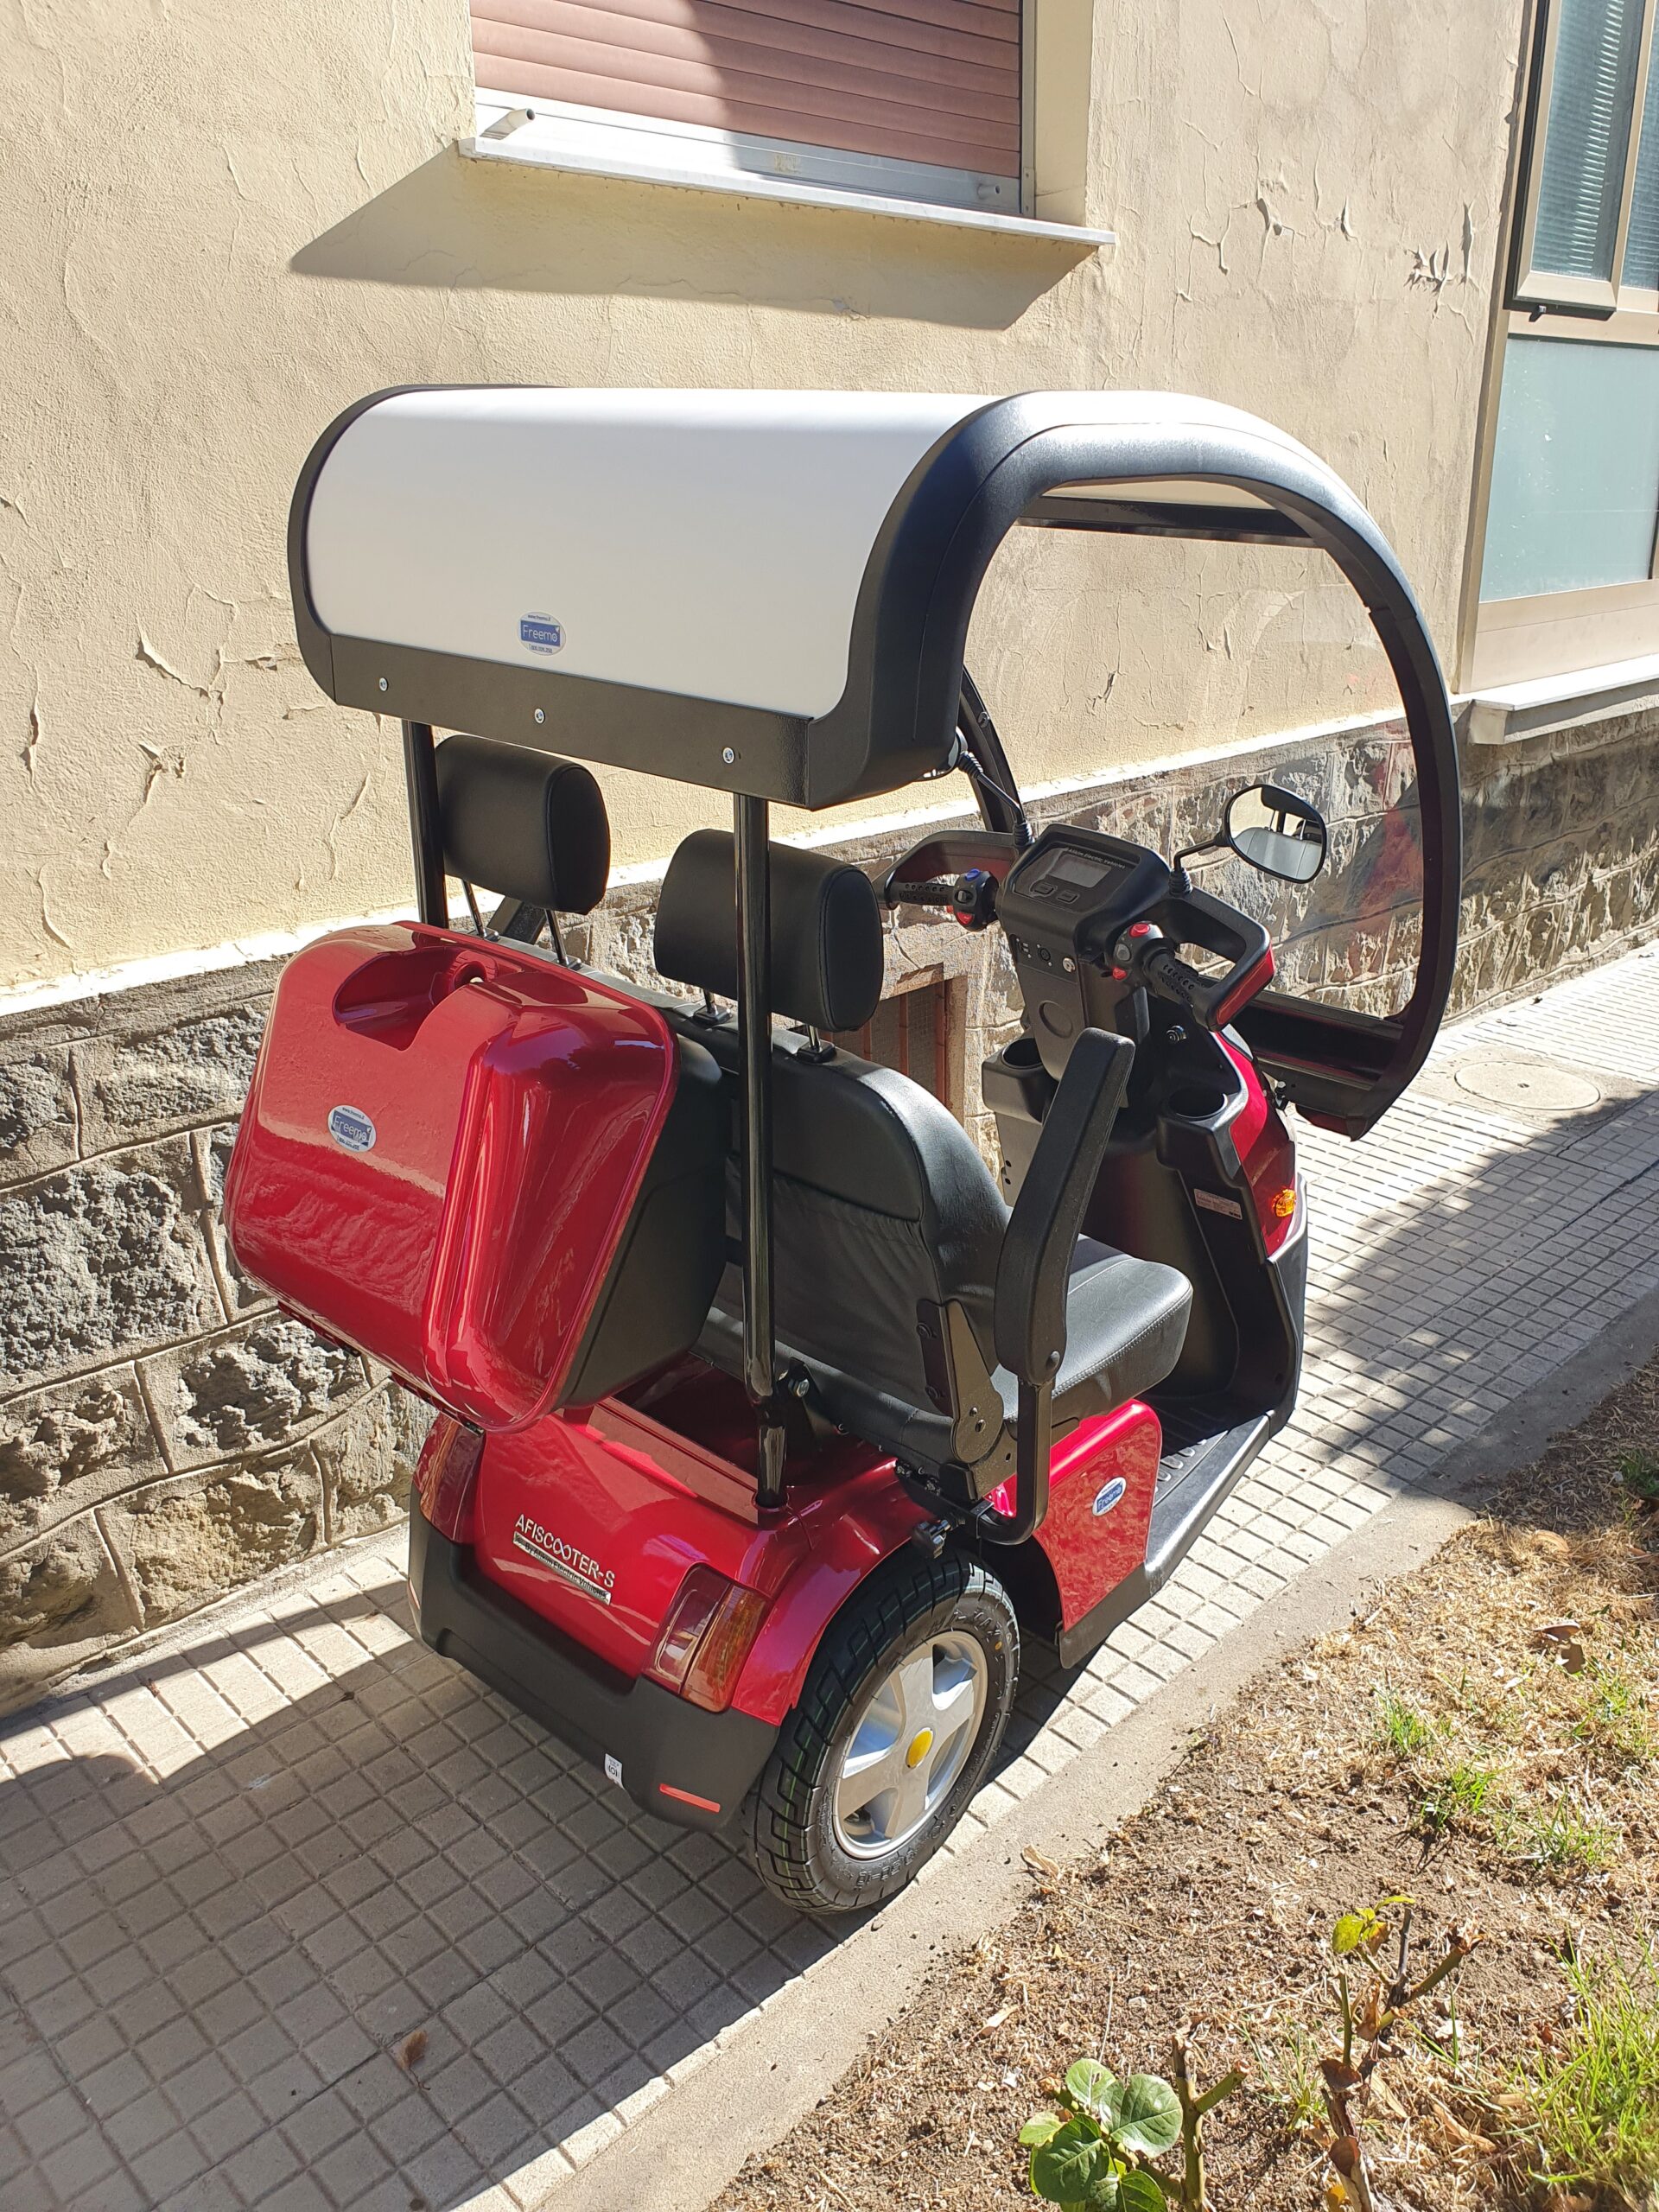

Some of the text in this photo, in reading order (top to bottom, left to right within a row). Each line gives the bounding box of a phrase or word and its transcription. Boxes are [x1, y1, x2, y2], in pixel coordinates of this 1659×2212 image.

[523, 624, 558, 642] Freemo
[334, 1115, 367, 1141] Freemo
[1097, 1486, 1122, 1510] Freemo
[515, 1514, 615, 1588] AFISCOOTER-S
